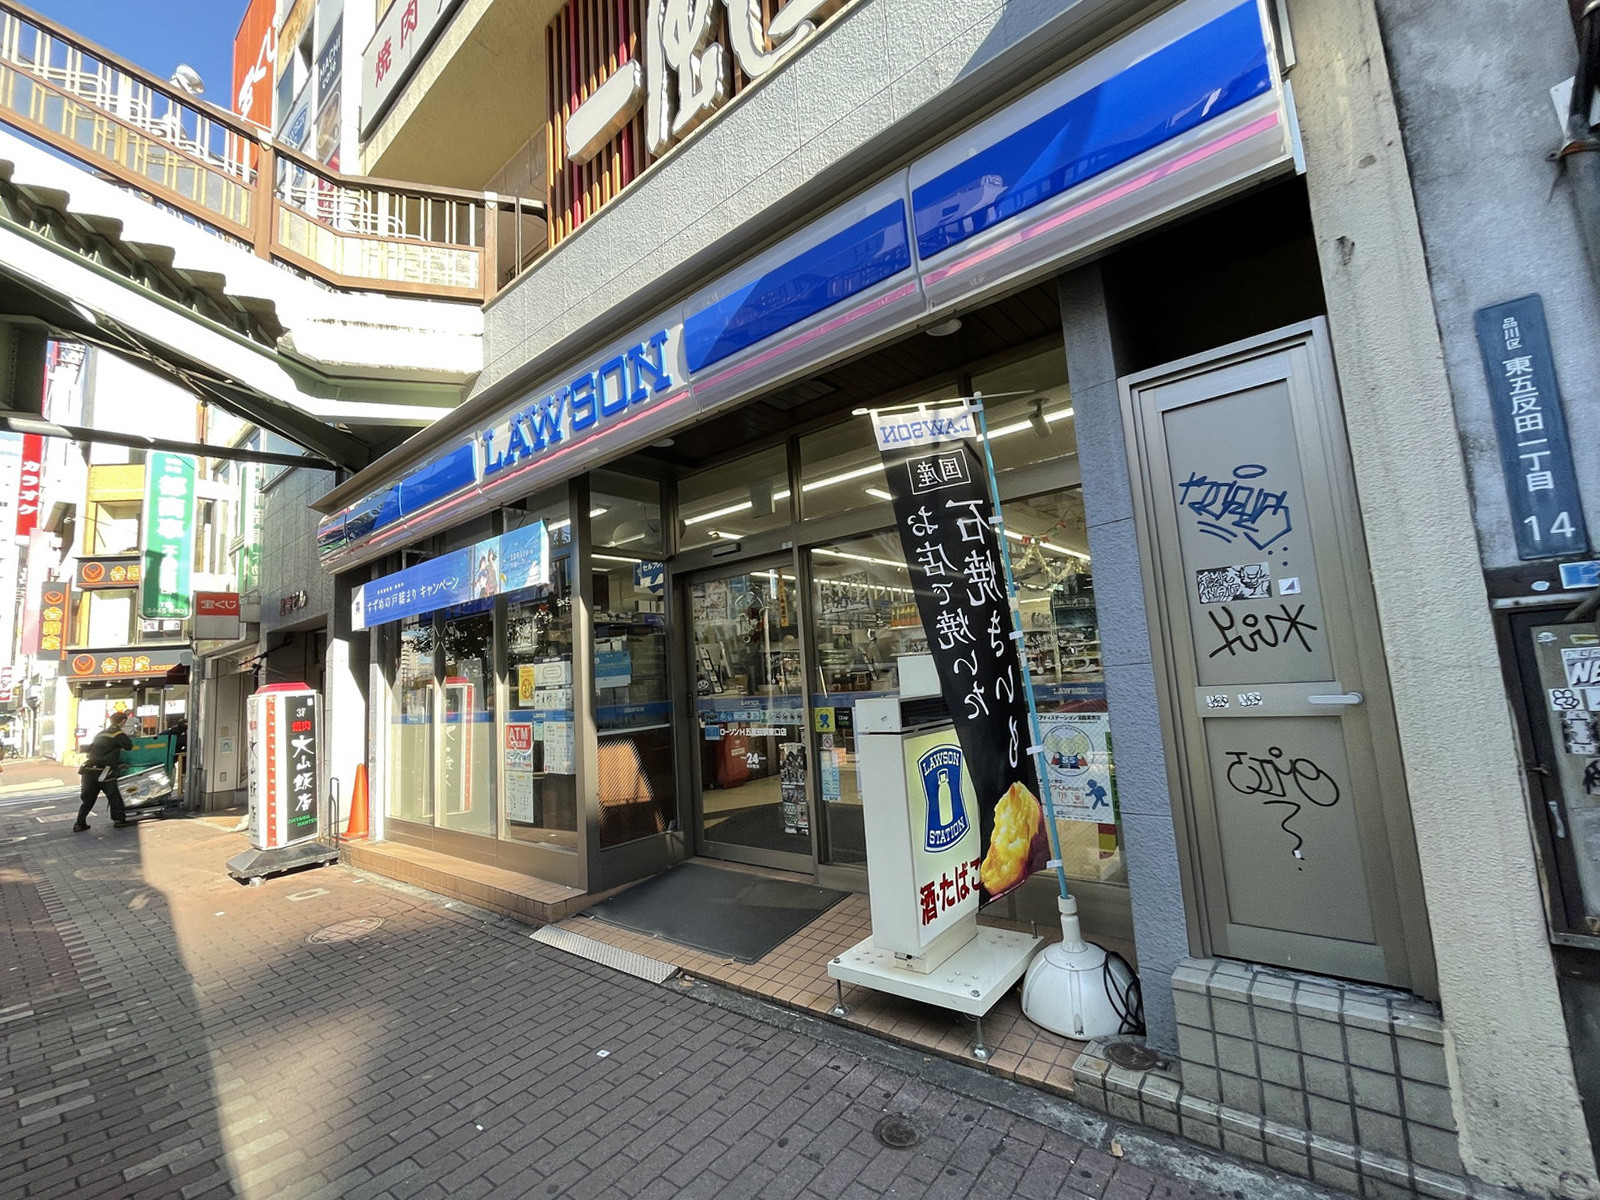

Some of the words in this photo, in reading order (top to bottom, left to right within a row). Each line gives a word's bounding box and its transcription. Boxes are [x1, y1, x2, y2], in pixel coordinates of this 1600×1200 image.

[319, 35, 341, 82] MACHI
[1502, 317, 1522, 350] 品川区
[482, 328, 673, 475] LAWSON
[1502, 355, 1554, 492] 東五反田一丁目
[1524, 511, 1576, 541] 14
[201, 599, 237, 610] 宝くじ
[366, 589, 417, 615] すずめの戸締まり
[419, 576, 460, 597] キャンペーン
[296, 708, 306, 718] 3F
[508, 728, 528, 740] ATM
[746, 752, 759, 764] 24
[922, 750, 960, 776] LAWSON
[291, 735, 315, 812] 大山飯店
[929, 816, 967, 845] STATION
